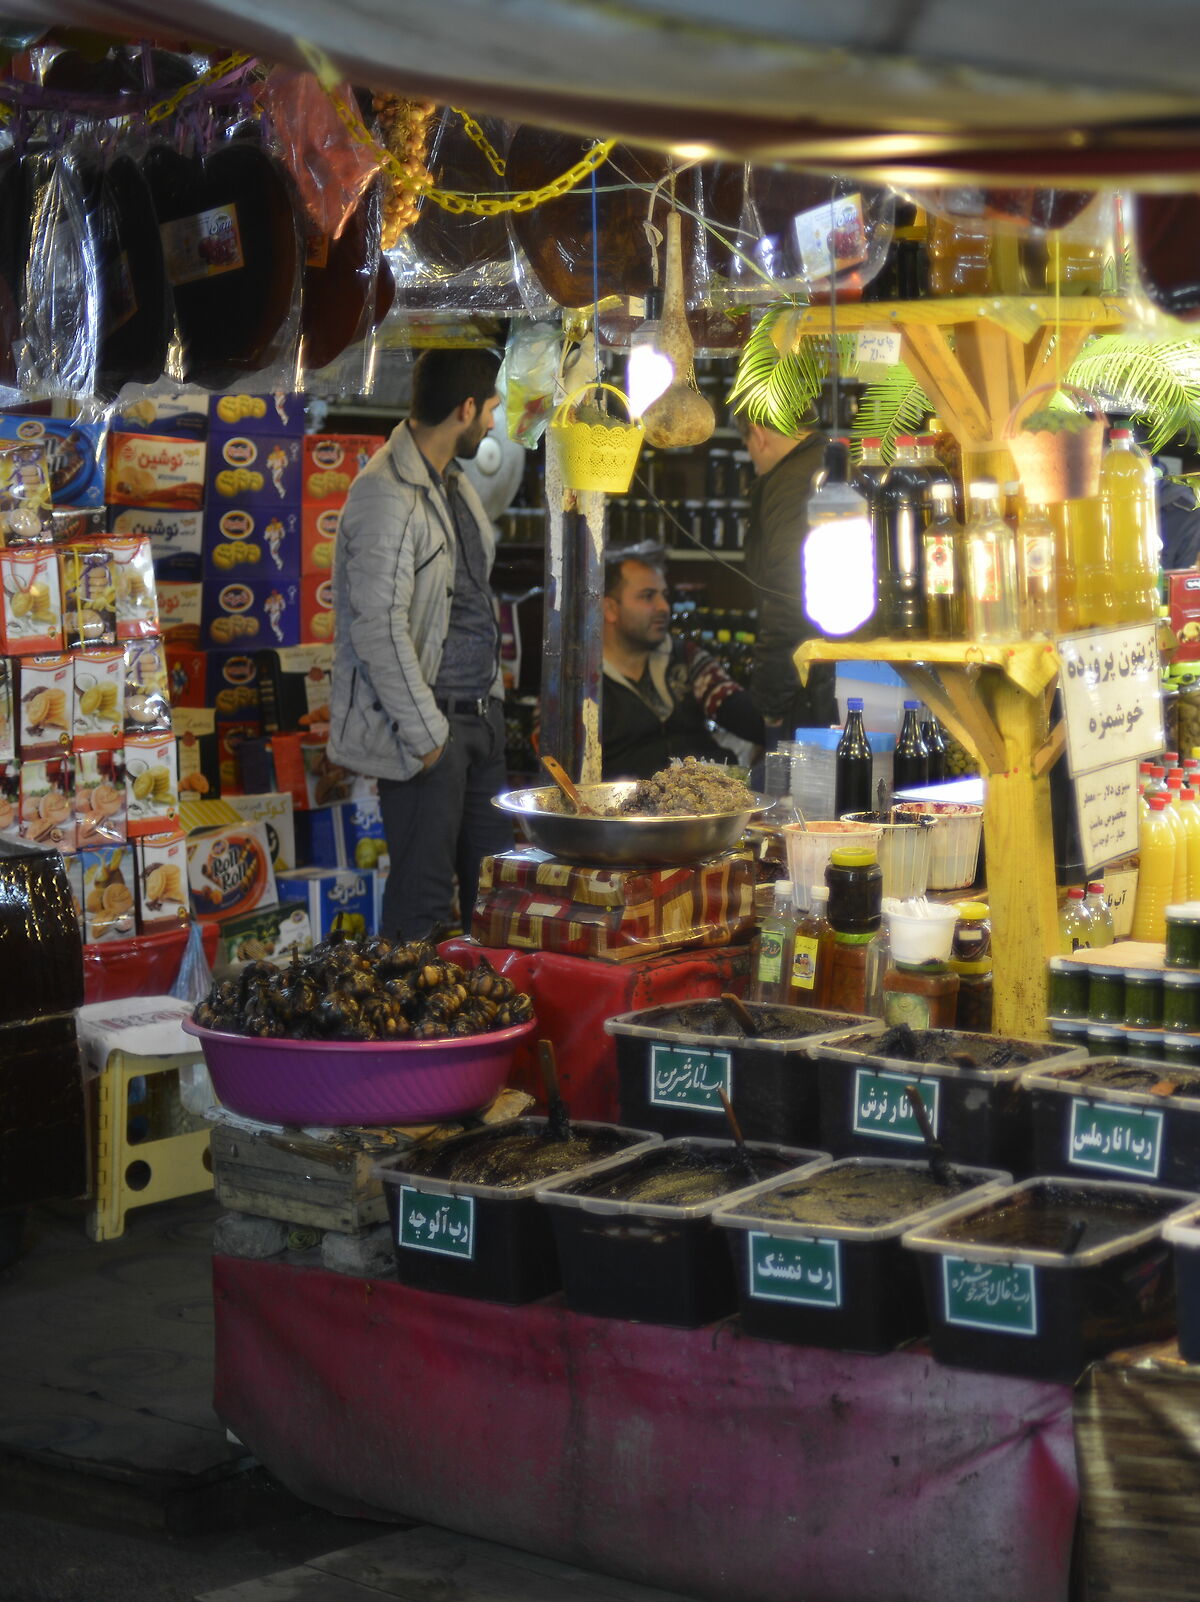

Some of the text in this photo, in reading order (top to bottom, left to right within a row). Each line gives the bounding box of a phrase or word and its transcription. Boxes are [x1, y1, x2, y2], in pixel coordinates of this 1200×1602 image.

[137, 448, 184, 472] نوشین
[1088, 699, 1144, 740] خوشمزه
[213, 848, 239, 879] Roll
[221, 863, 248, 893] Roll
[1114, 889, 1127, 910] آب
[656, 1057, 723, 1099] رب انار شیرین
[860, 1087, 888, 1121] ترش
[1073, 1121, 1152, 1161] رب انار ملس
[408, 1206, 468, 1243] رب آلوچه
[757, 1252, 833, 1291] رب تمشک
